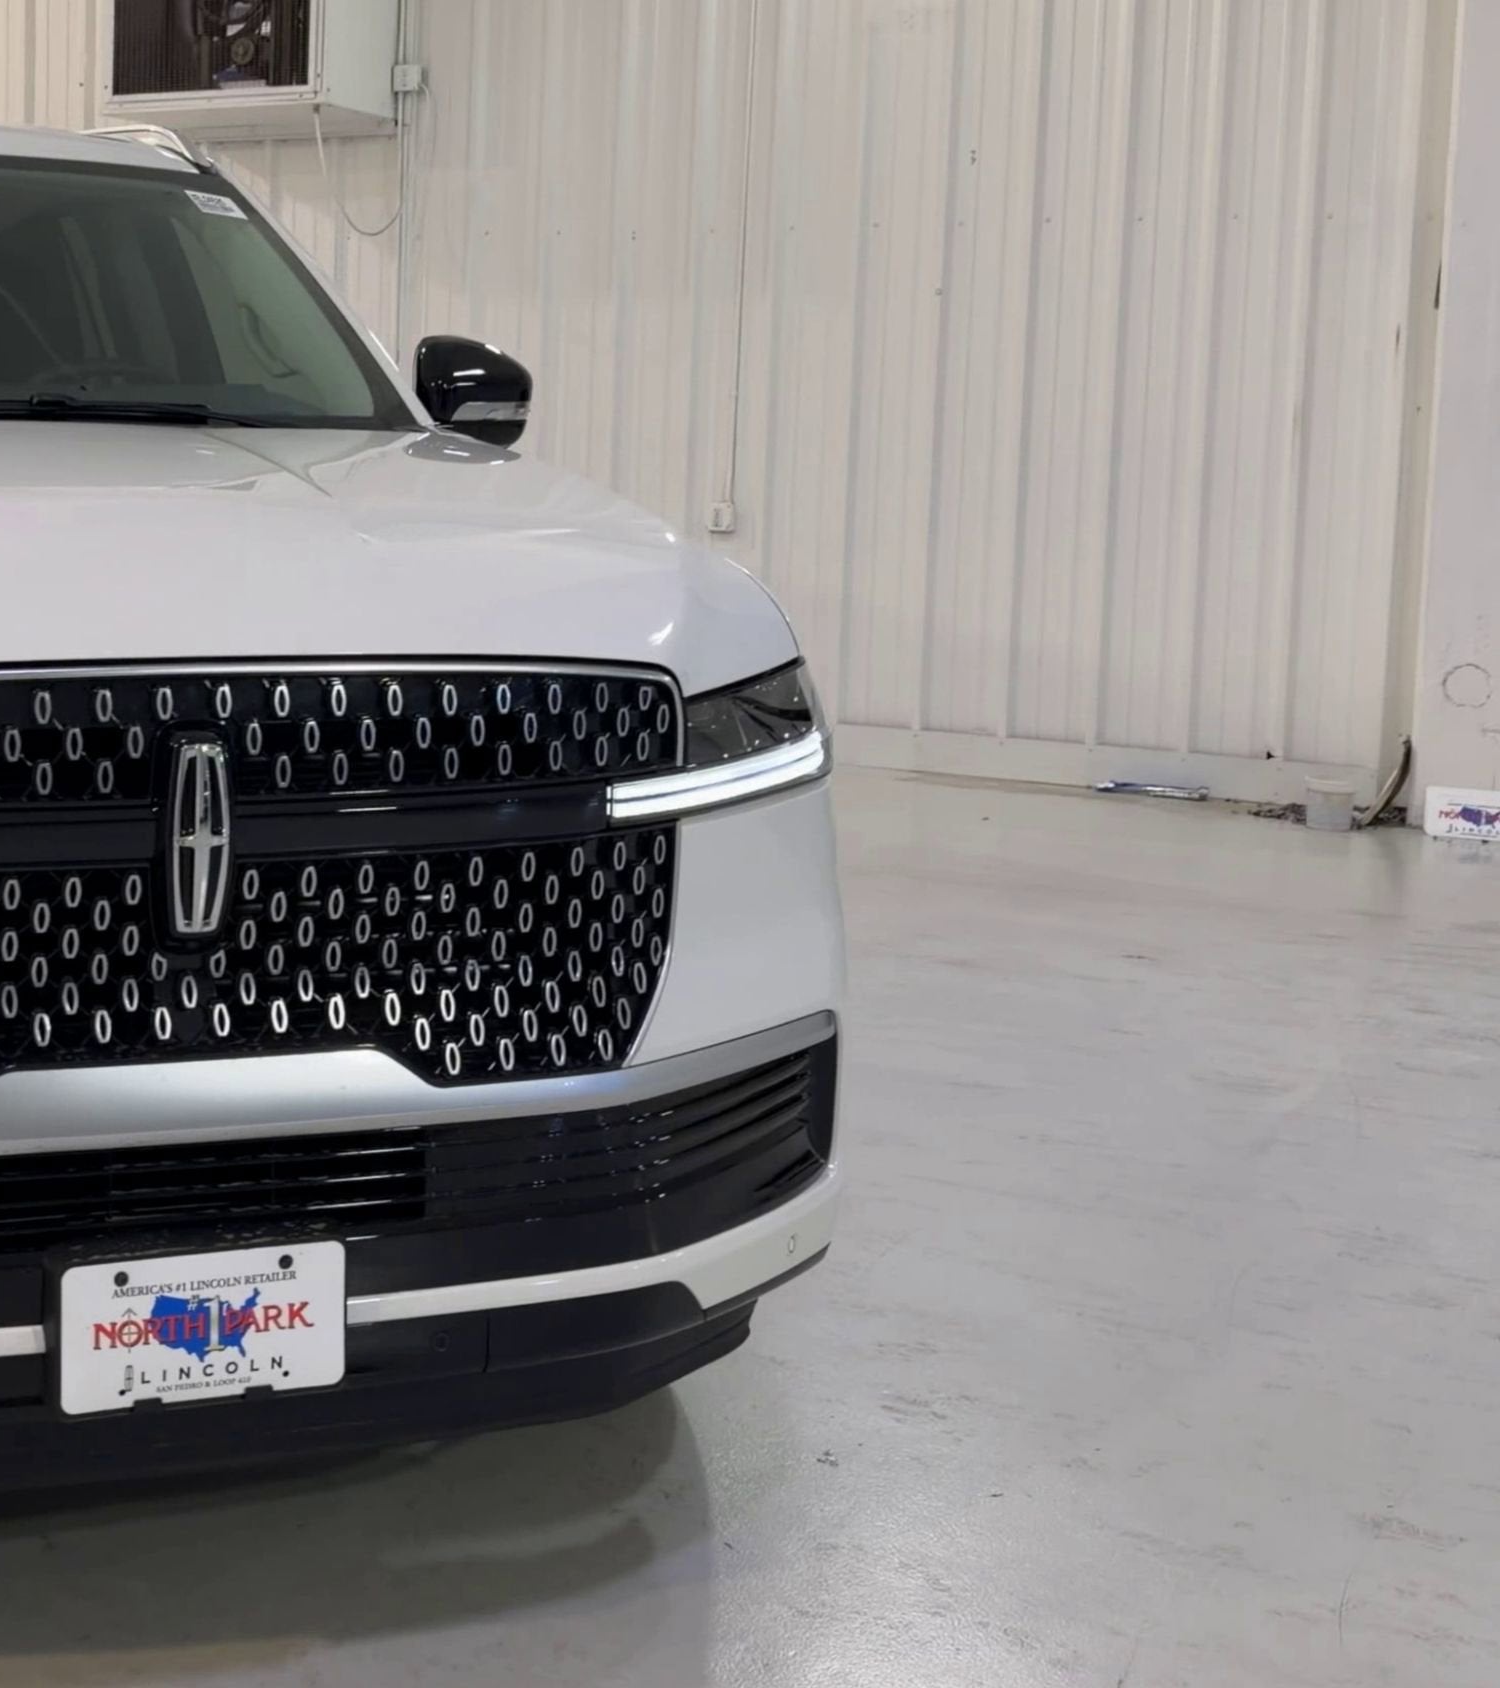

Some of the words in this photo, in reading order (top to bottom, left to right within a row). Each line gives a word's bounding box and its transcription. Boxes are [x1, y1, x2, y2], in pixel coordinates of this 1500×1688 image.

[112, 1283, 173, 1299] AMERICA'S
[175, 1281, 188, 1293] #1
[189, 1276, 243, 1292] LINCOLN
[244, 1270, 297, 1286] RETAILER
[92, 1313, 205, 1350] NORTH
[224, 1301, 315, 1336] PARK
[140, 1355, 284, 1385] LINCOLN
[213, 1378, 237, 1388] LOOP
